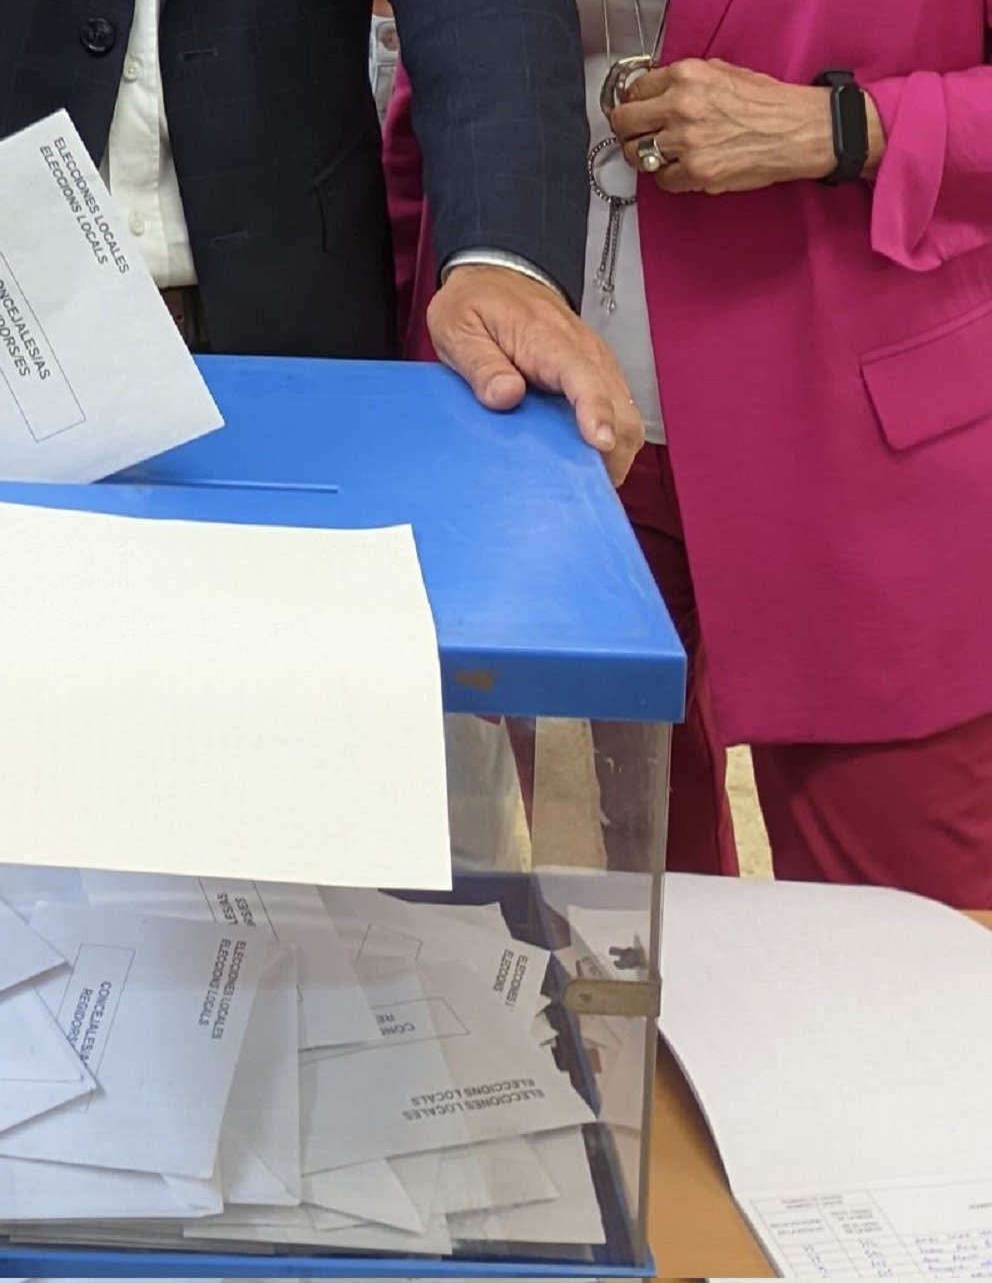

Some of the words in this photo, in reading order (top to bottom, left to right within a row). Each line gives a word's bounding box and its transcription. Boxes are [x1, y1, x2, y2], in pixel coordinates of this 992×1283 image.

[39, 145, 81, 213] ELECCIONS
[76, 215, 109, 266] LOCALS
[53, 136, 100, 215] ELECCIONES
[94, 214, 130, 274] LOCALES
[223, 940, 247, 996] ELECCIONES
[198, 989, 219, 1026] LOCALS
[211, 997, 232, 1040] LOCALES
[410, 1089, 462, 1106] LOCALS
[464, 1078, 536, 1097] ELECCIONS
[466, 1088, 546, 1110] ELECCIONES
[402, 1102, 464, 1121] LOCALES
